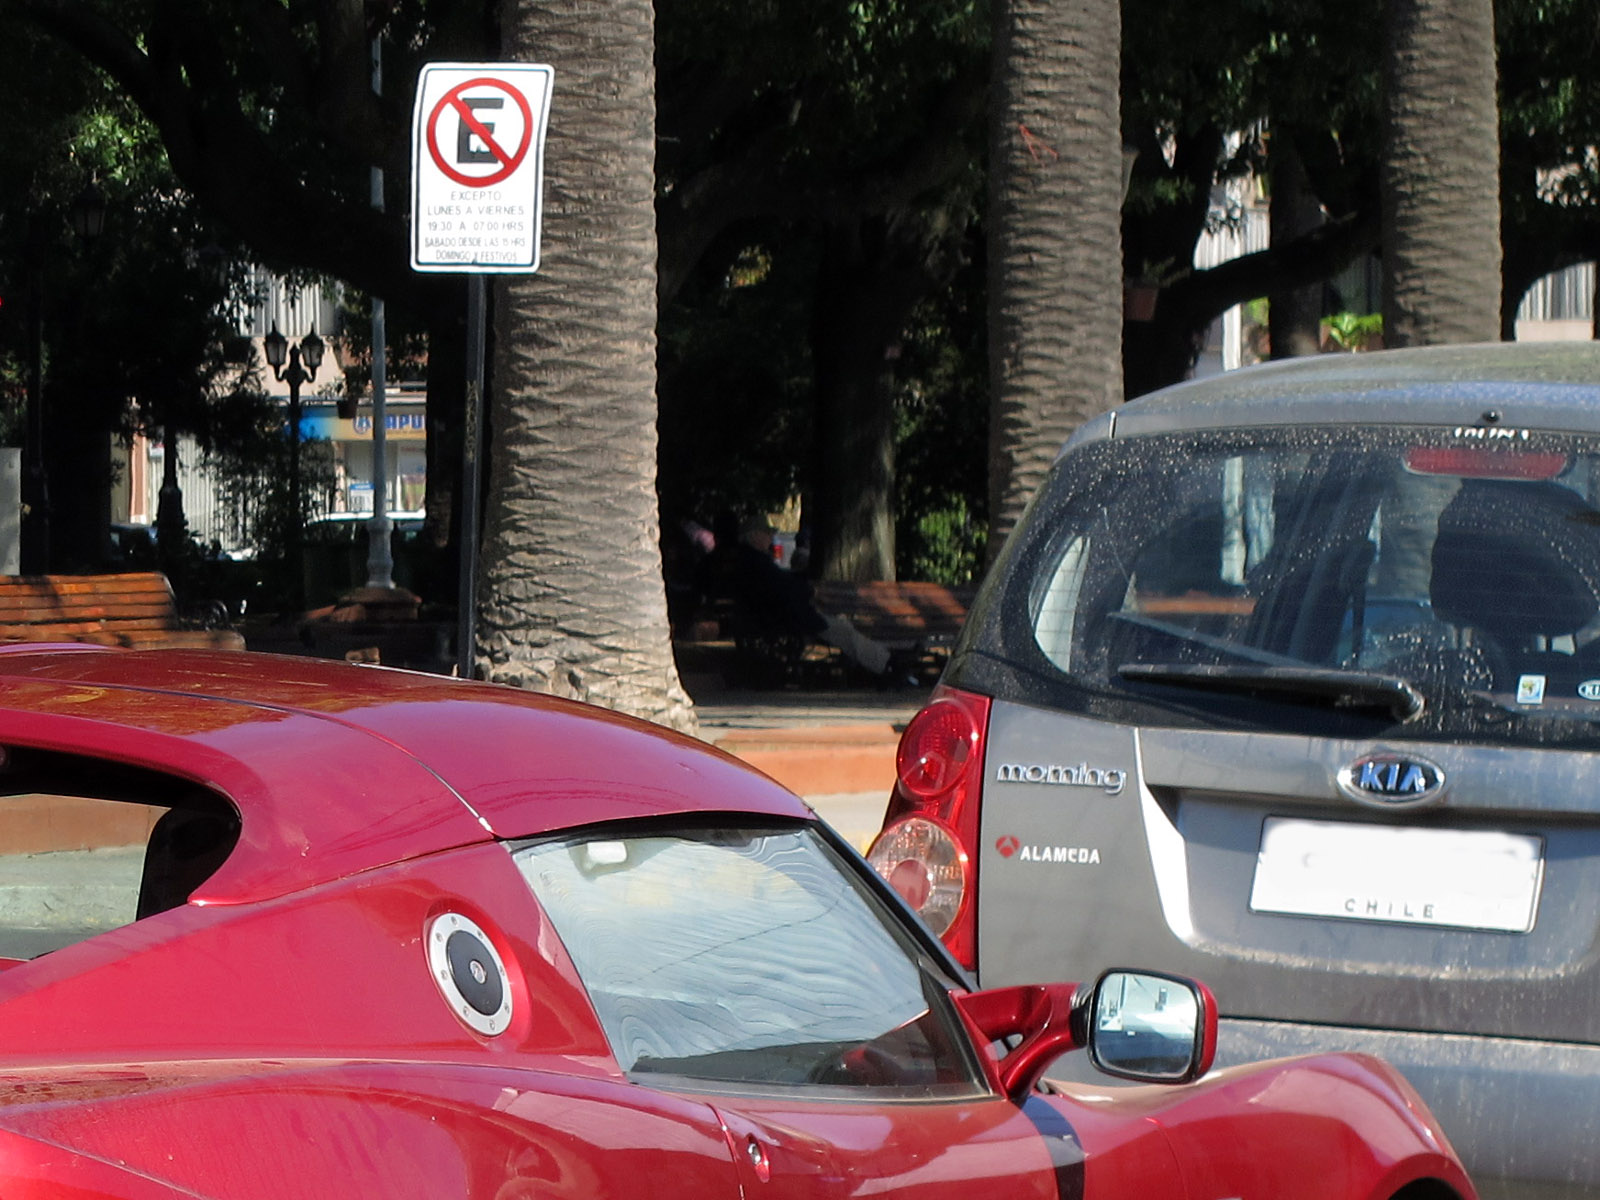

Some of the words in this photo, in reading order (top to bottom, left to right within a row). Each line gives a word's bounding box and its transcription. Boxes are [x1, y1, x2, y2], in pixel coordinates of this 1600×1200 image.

[450, 190, 502, 201] EXCEPTO
[427, 205, 461, 216] LUNES
[465, 205, 473, 215] A
[478, 205, 525, 216] VIERNES
[459, 221, 467, 231] A
[424, 236, 456, 248] SABADO
[458, 236, 482, 247] DESDE
[484, 237, 499, 247] LAS
[435, 249, 471, 261] DOMINGO
[480, 251, 518, 263] FESTIVOS
[1584, 685, 1600, 697] KI
[996, 762, 1128, 795] morning
[1359, 762, 1426, 793] KIA
[1019, 845, 1101, 864] ALAMEDA
[1344, 898, 1435, 919] CHILE
